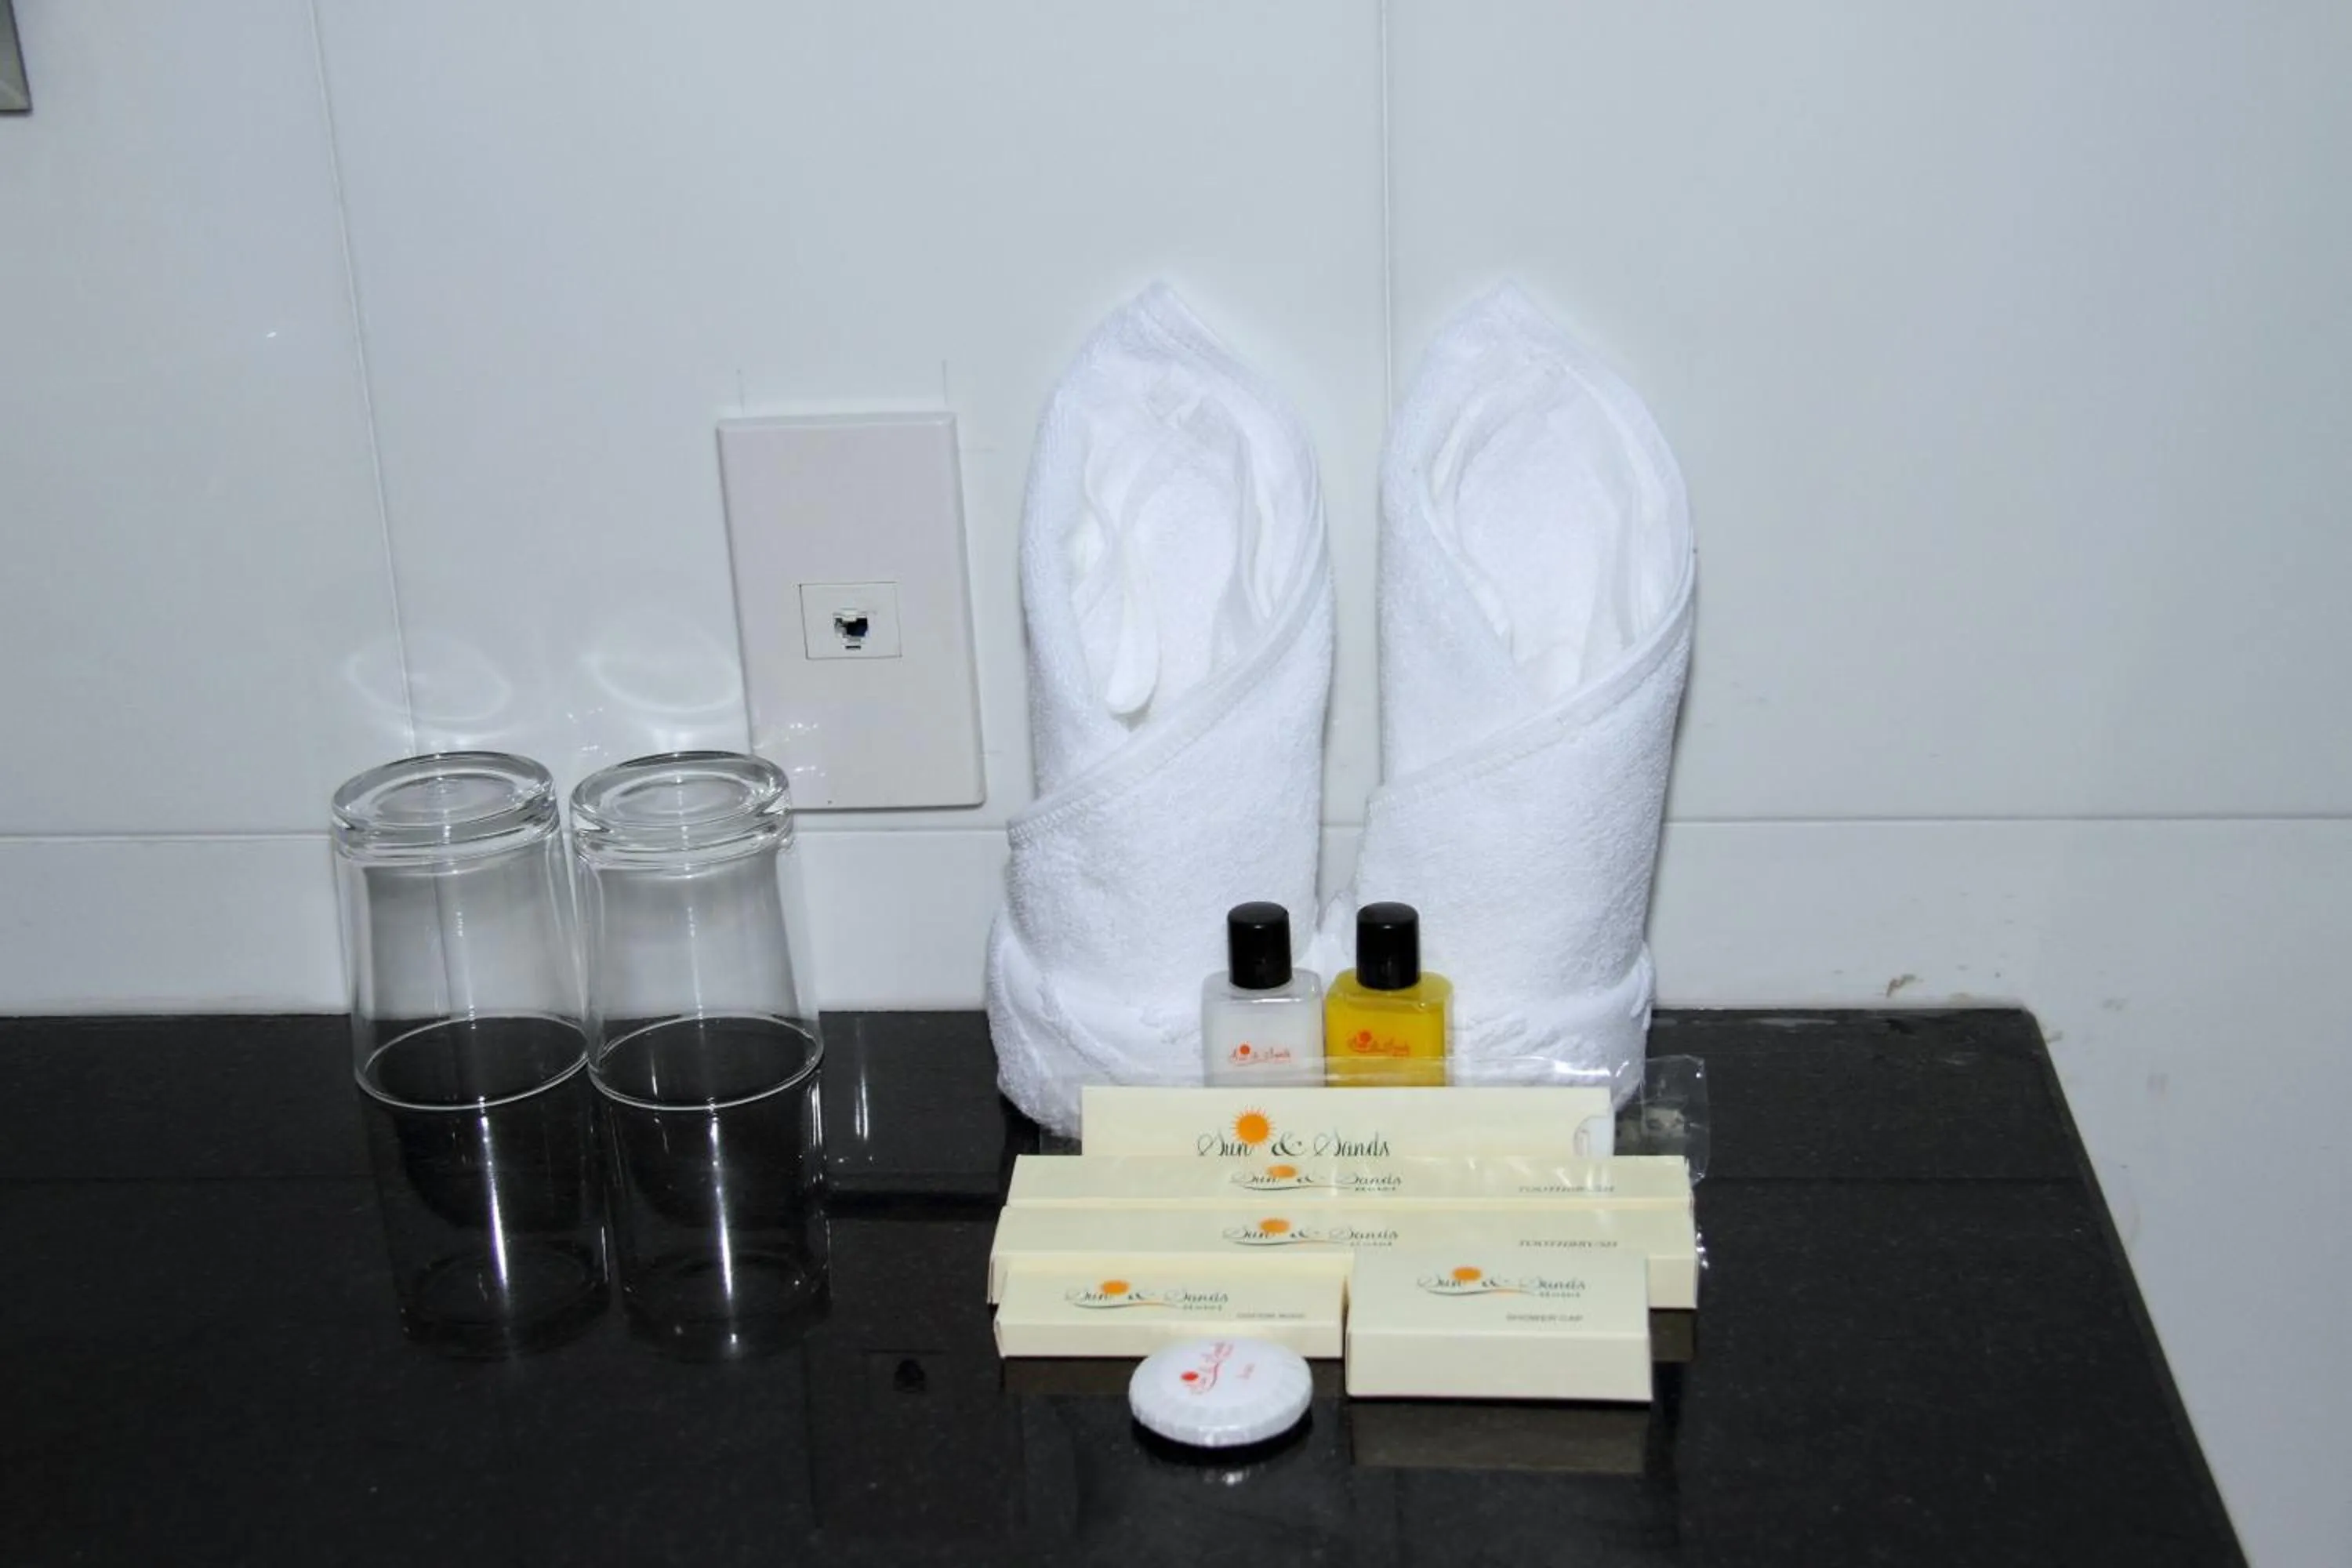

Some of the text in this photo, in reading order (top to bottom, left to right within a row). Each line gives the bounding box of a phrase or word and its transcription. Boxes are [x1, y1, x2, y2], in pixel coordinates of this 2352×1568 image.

[1196, 1128, 1391, 1156] Sun & Sands
